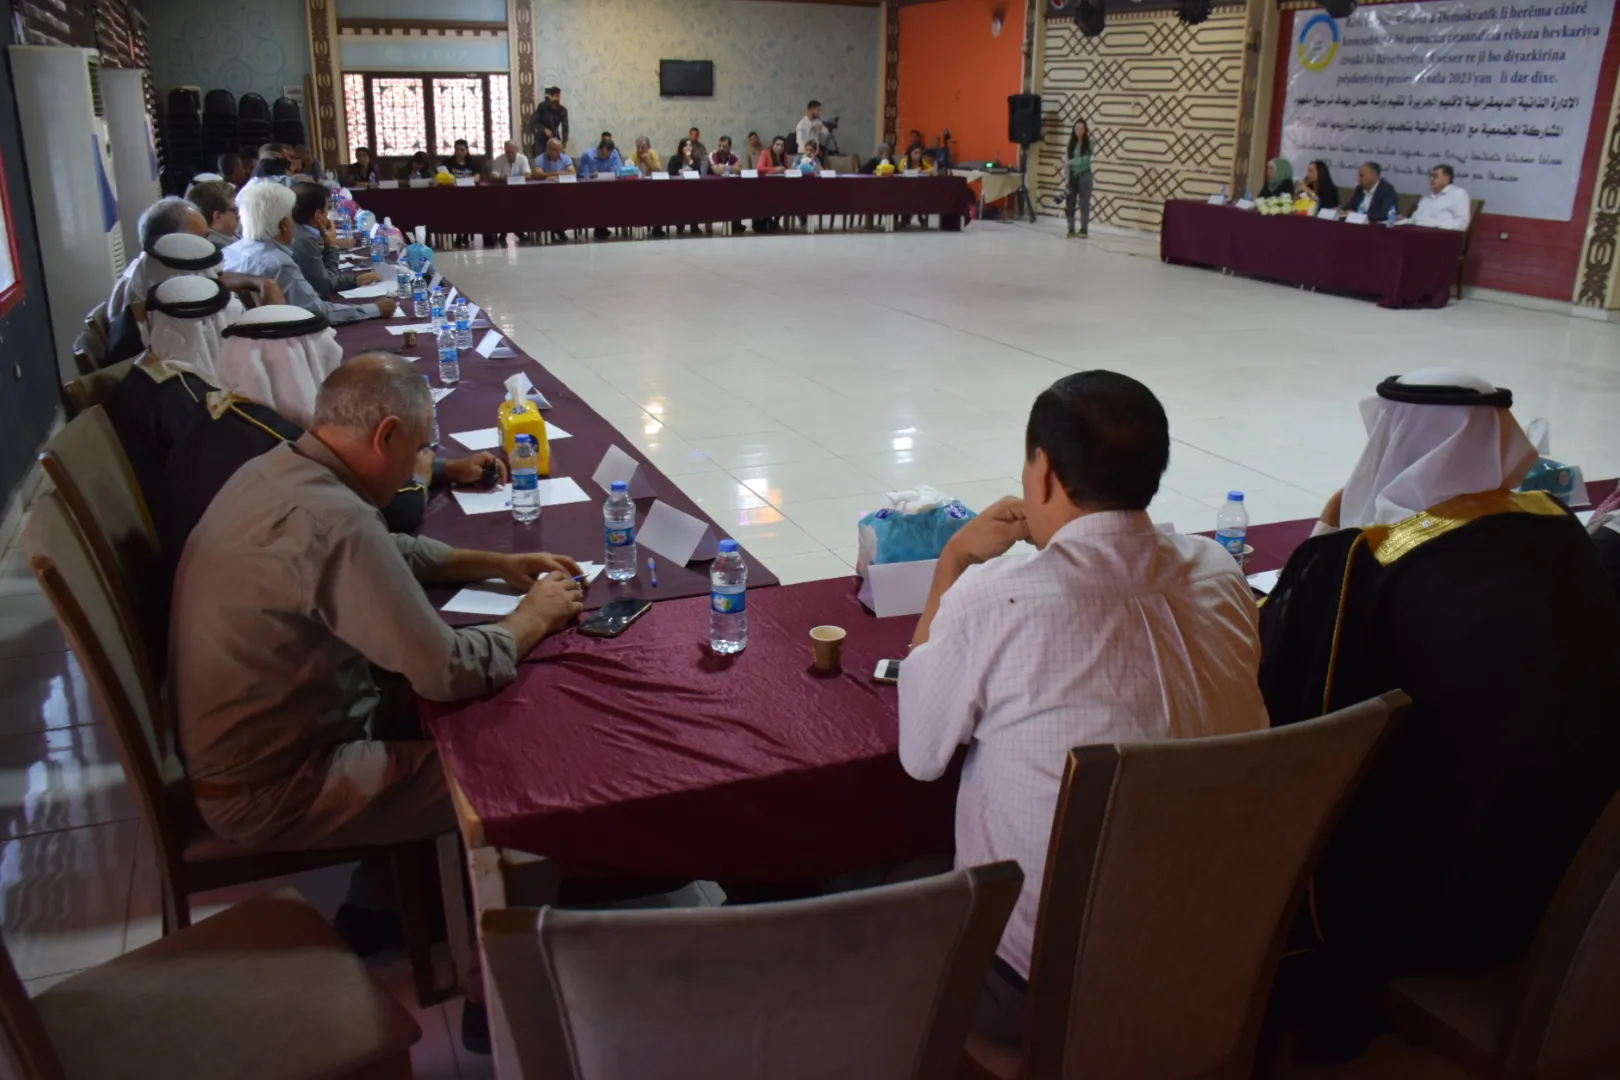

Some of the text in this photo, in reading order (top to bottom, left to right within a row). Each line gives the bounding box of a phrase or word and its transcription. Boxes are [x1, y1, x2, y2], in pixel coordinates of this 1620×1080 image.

[1488, 51, 1502, 63] bo
[1500, 70, 1508, 83] li
[1510, 70, 1529, 83] dar
